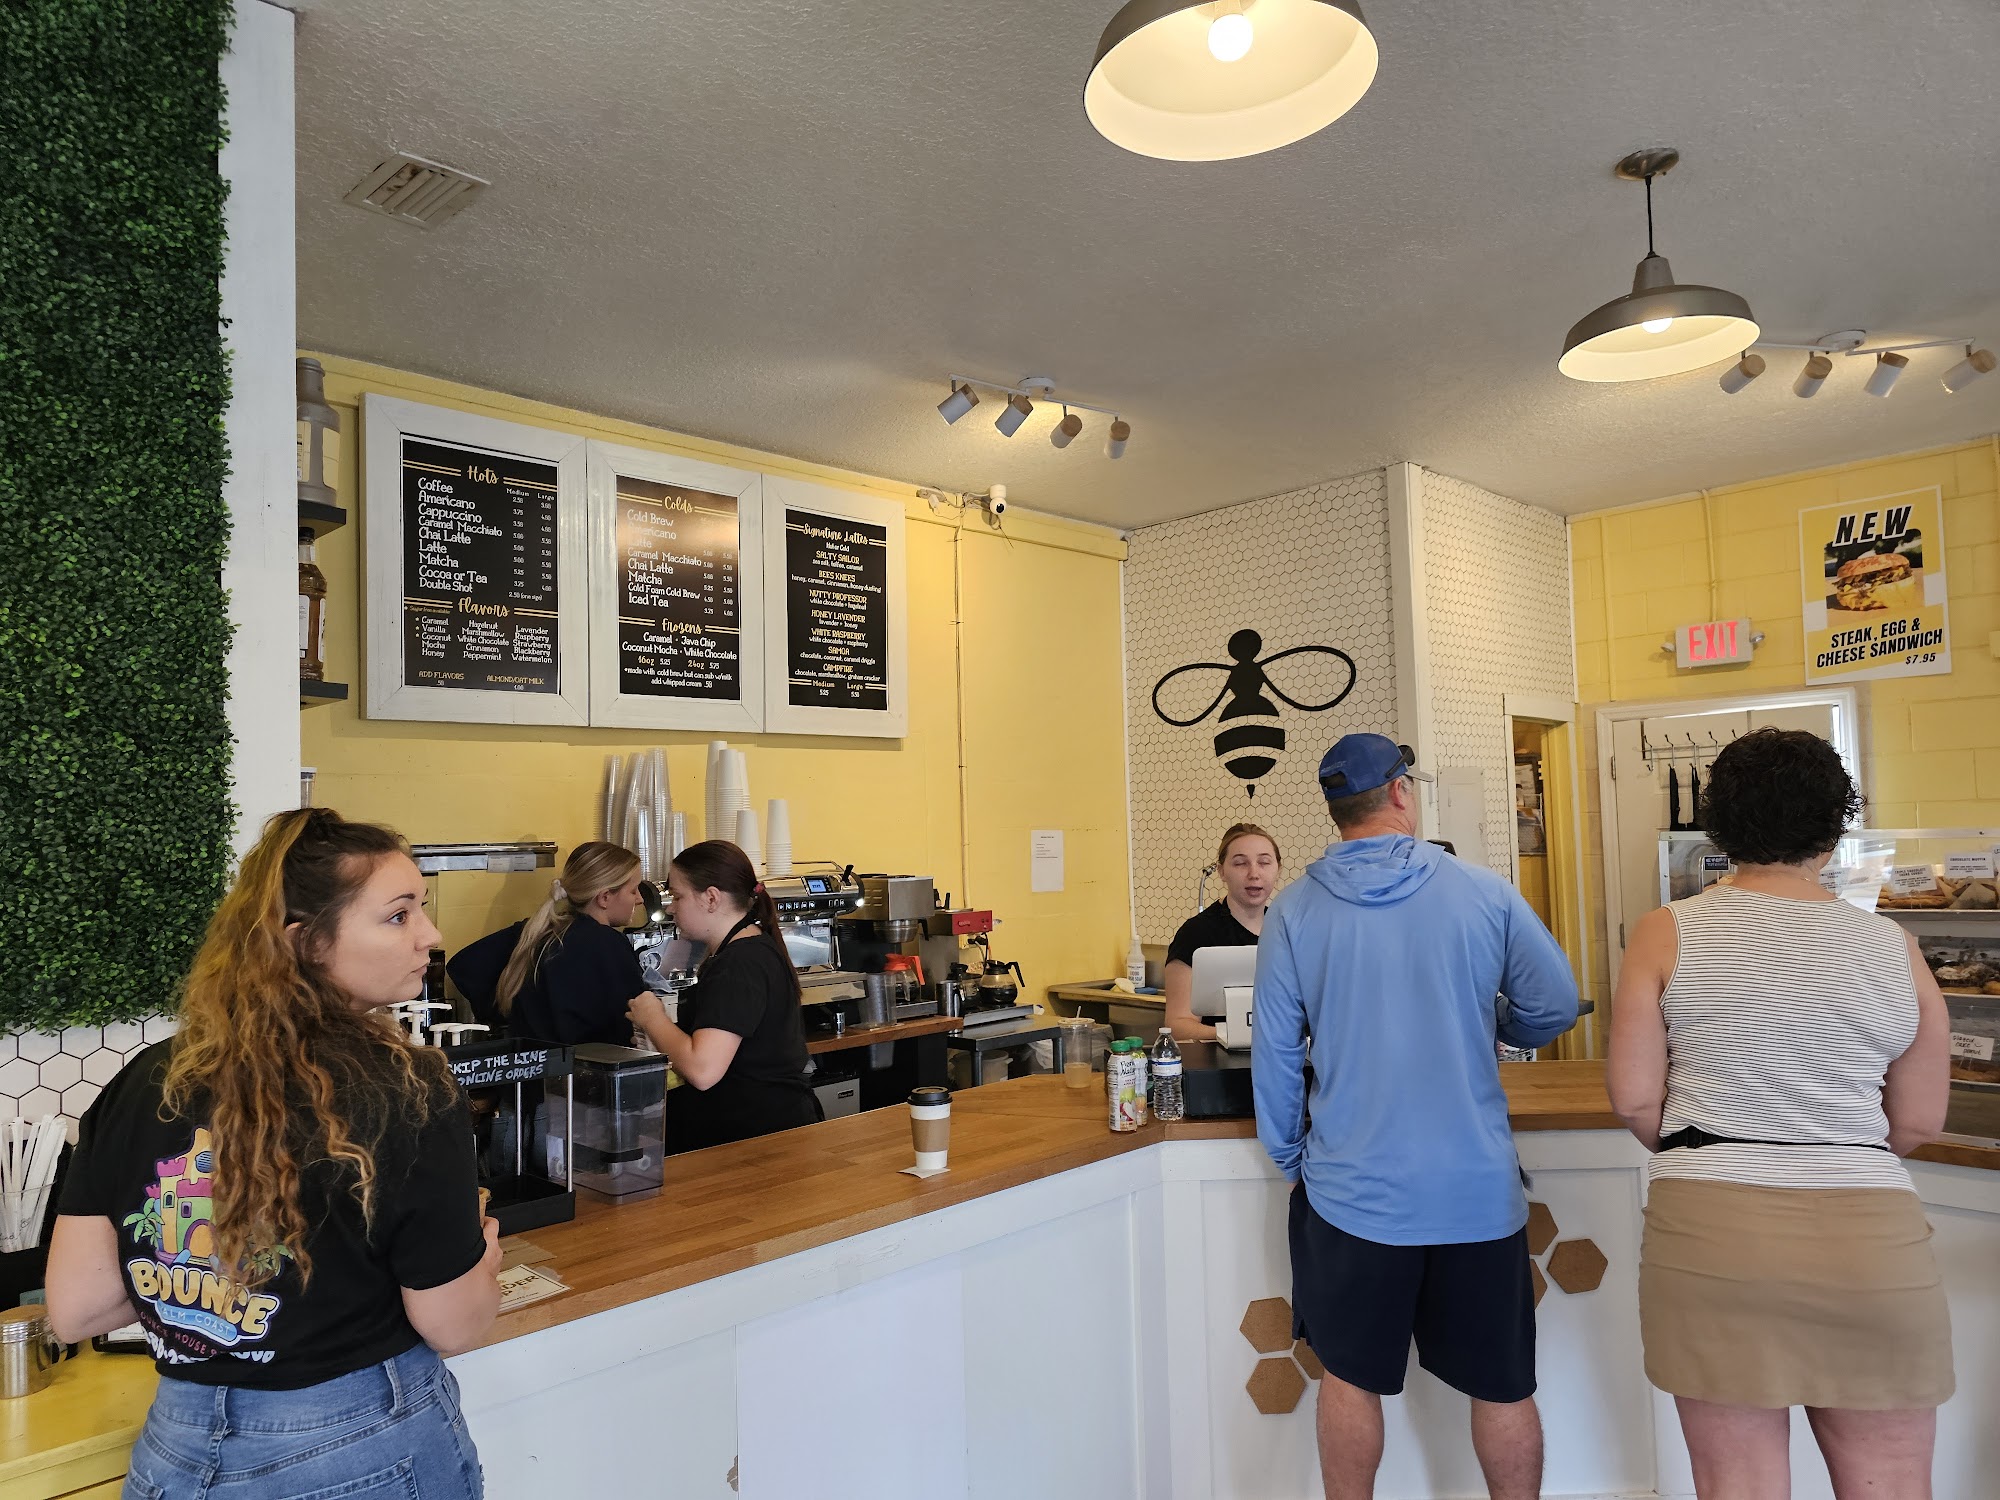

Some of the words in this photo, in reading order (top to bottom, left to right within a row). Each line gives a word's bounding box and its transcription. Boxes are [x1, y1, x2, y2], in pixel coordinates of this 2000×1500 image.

[468, 465, 499, 484] Hots
[418, 478, 453, 493] Coffee
[418, 491, 475, 509] Americano
[665, 496, 693, 513] Colds
[418, 504, 482, 522] Cappuccino
[627, 509, 647, 522] Cold
[650, 513, 673, 526] Brew
[418, 517, 453, 529] Caramel
[458, 521, 502, 536] Macchiato
[1833, 505, 1913, 546] NEW
[419, 528, 441, 540] Chai
[444, 530, 471, 544] Latte
[803, 523, 842, 540] Signature
[844, 532, 868, 544] Lattes
[419, 540, 447, 553] Latte
[419, 553, 459, 568] Matcha
[628, 548, 658, 560] Caramel
[662, 552, 701, 566] Macchiato
[816, 551, 837, 560] SALTY
[838, 554, 859, 564] SAILOR
[628, 558, 647, 571] Chai
[650, 561, 673, 574] Latte
[419, 565, 451, 580] Cocoa
[454, 571, 465, 580] or
[467, 571, 487, 583] Tea
[628, 570, 662, 585] Matcha
[819, 570, 834, 579] BEES
[835, 573, 855, 582] KNEES
[420, 578, 451, 590] Double
[452, 582, 472, 593] Shot
[628, 582, 644, 592] Cold
[646, 585, 665, 595] Foam
[666, 587, 681, 597] Cold
[683, 589, 700, 599] Brew
[629, 592, 649, 605] Iced
[651, 594, 668, 607] Tea
[809, 589, 832, 599] NUTTY
[833, 592, 867, 603] PROFESSOR
[458, 597, 510, 617] Flavors
[422, 616, 449, 626] Caramel
[811, 610, 832, 619] HONEY
[834, 613, 865, 623] LAVENDER
[422, 625, 446, 633] Vanilla
[469, 620, 498, 629] Hazelnut
[516, 625, 548, 635] Lavender
[422, 632, 451, 642] Coconut
[457, 635, 476, 644] White
[478, 638, 509, 646] Chocolate
[462, 628, 504, 638] Marshmallow
[515, 633, 549, 643] Raspberry
[643, 632, 672, 643] Caramel
[682, 636, 698, 645] Java
[700, 638, 716, 649] Chip
[811, 628, 831, 636] WHITE
[832, 630, 866, 640] RASPBERRY
[1831, 626, 1877, 648] STEAK,
[1881, 619, 1906, 638] EGG
[1911, 618, 1921, 631] &
[422, 640, 445, 649] Mocha
[466, 644, 499, 653] Cinnamon
[513, 640, 551, 650] Strawberry
[1688, 621, 1738, 662] EXIT
[1817, 645, 1865, 668] CHEESE
[1870, 628, 1942, 657] SANDWICH
[422, 649, 444, 658] Honey
[464, 651, 501, 661] Peppermint
[512, 654, 552, 663] Watermelon
[514, 647, 550, 657] Blackberry
[622, 642, 652, 653] Coconut
[654, 645, 678, 655] Mocha
[684, 647, 704, 657] White
[705, 649, 737, 660] Chocolate
[828, 647, 849, 655] SAMOA
[1905, 653, 1936, 665] $7.95
[823, 664, 853, 672] CAMPFIRE
[434, 672, 464, 680] FLAVORS
[484, 1055, 509, 1068] THE
[514, 1050, 548, 1064] LINE
[506, 1064, 543, 1080] ORDERS
[128, 1260, 278, 1336] BOUNCE
[195, 1314, 229, 1336] COAST
[175, 1332, 206, 1355] HOUSE
